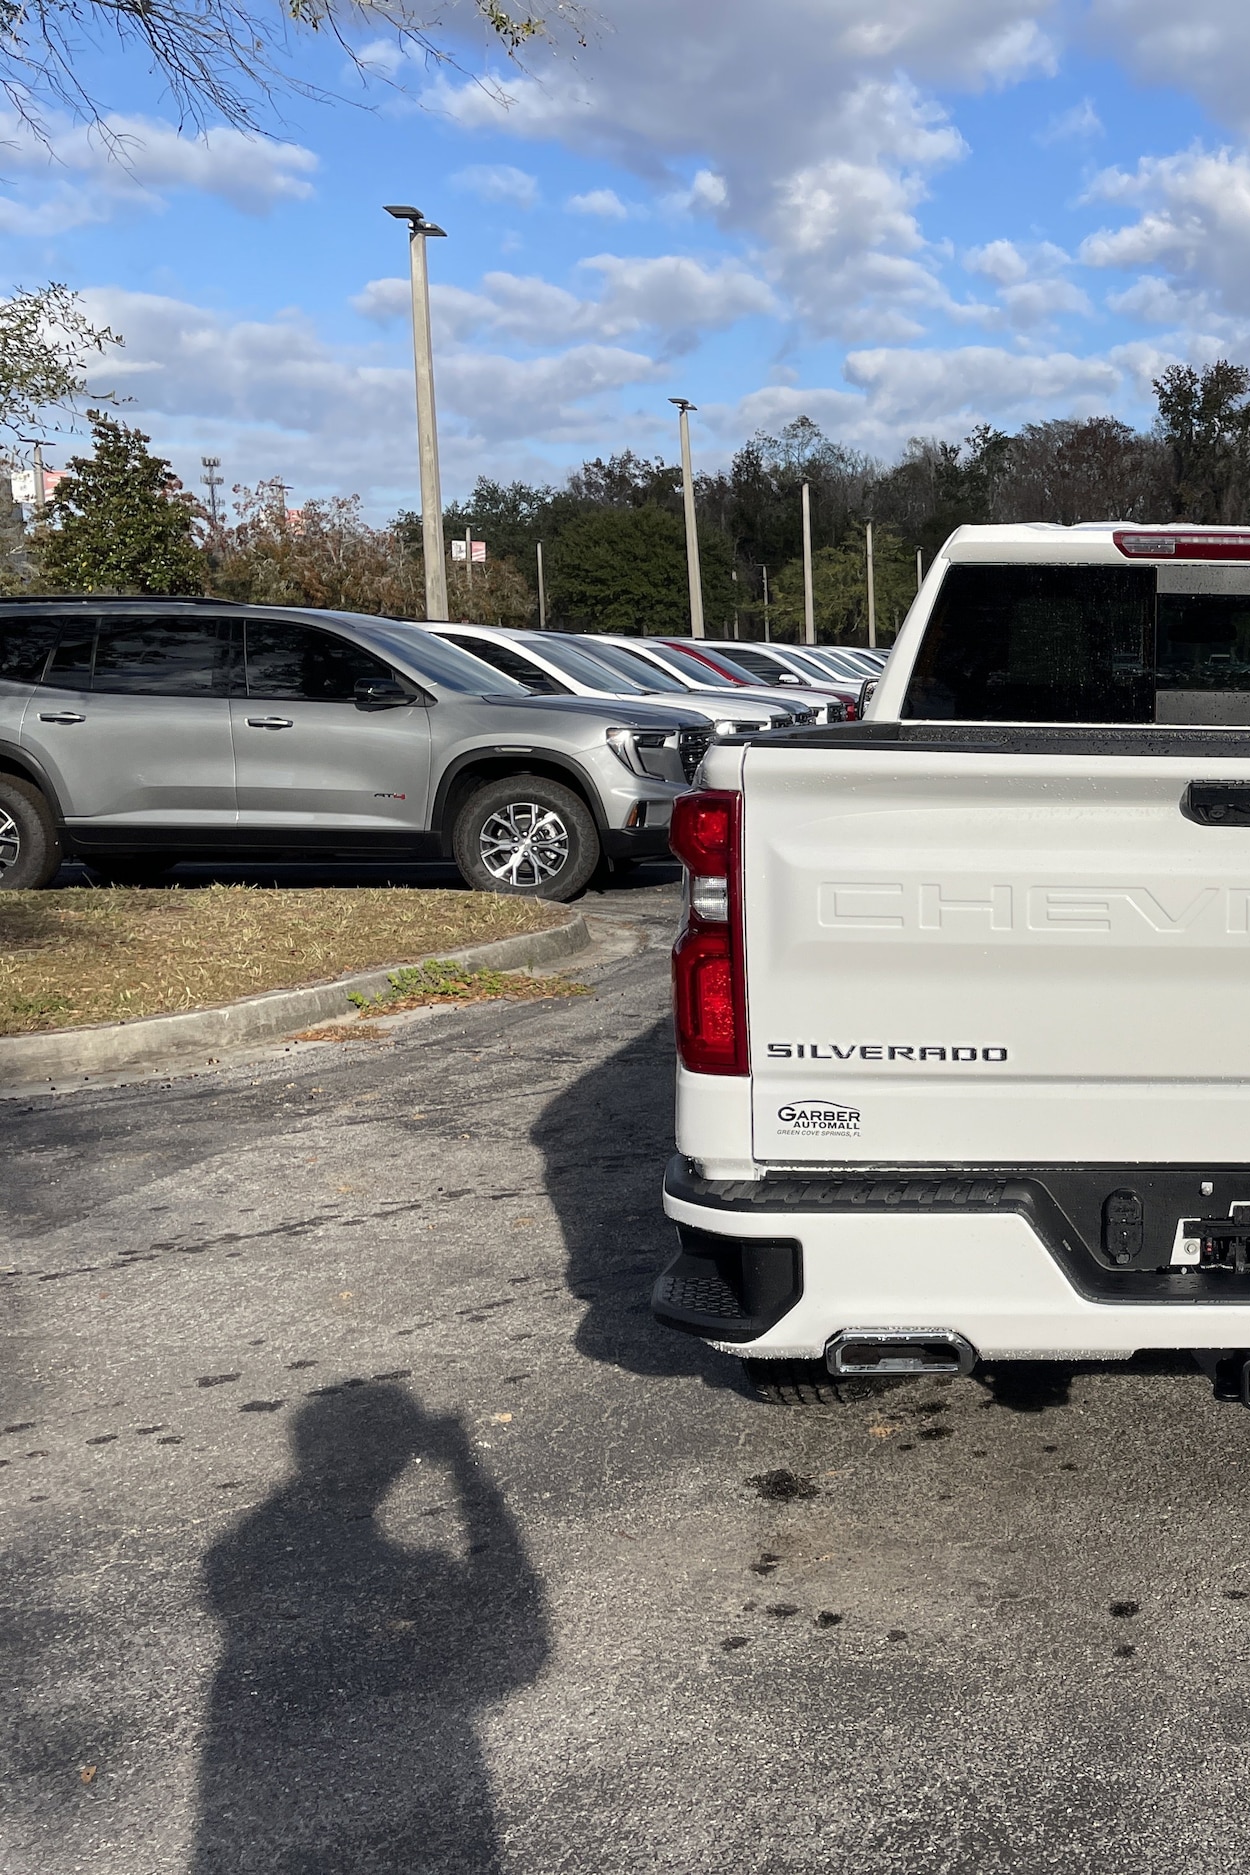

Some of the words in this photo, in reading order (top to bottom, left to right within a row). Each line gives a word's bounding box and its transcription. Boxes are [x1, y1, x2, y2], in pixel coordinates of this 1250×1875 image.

[767, 1043, 1008, 1062] SILVERADO
[777, 1106, 861, 1122] GARBER
[793, 1121, 860, 1129] AUTOMALL
